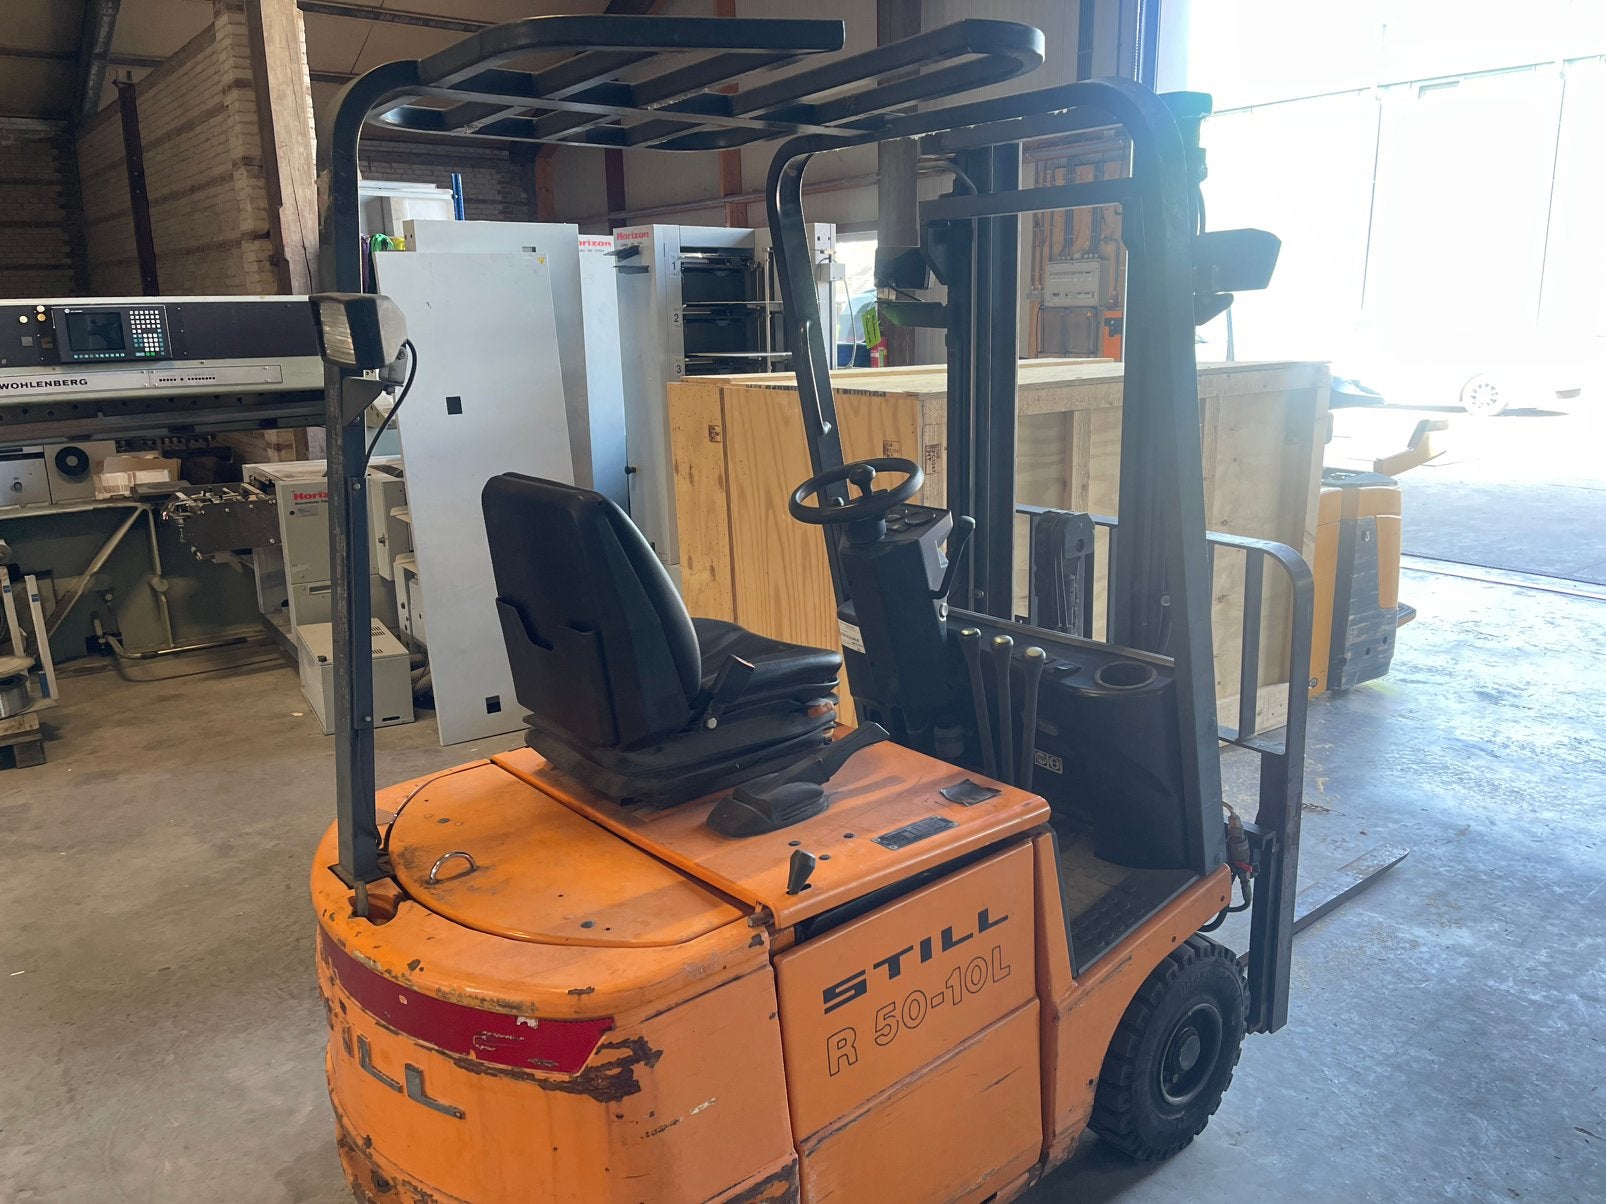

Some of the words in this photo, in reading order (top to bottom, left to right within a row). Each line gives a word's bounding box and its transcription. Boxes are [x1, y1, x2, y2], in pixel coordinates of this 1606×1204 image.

[617, 231, 649, 240] Horizon
[579, 240, 612, 248] orizon
[672, 261, 676, 271] 1
[674, 313, 680, 323] 2
[676, 364, 682, 374] 3
[0, 378, 88, 390] WOHLENBERG
[294, 491, 329, 501] Horiz
[823, 908, 1008, 1014] STILL
[826, 1026, 858, 1078] R
[874, 945, 1010, 1046] 50-10L
